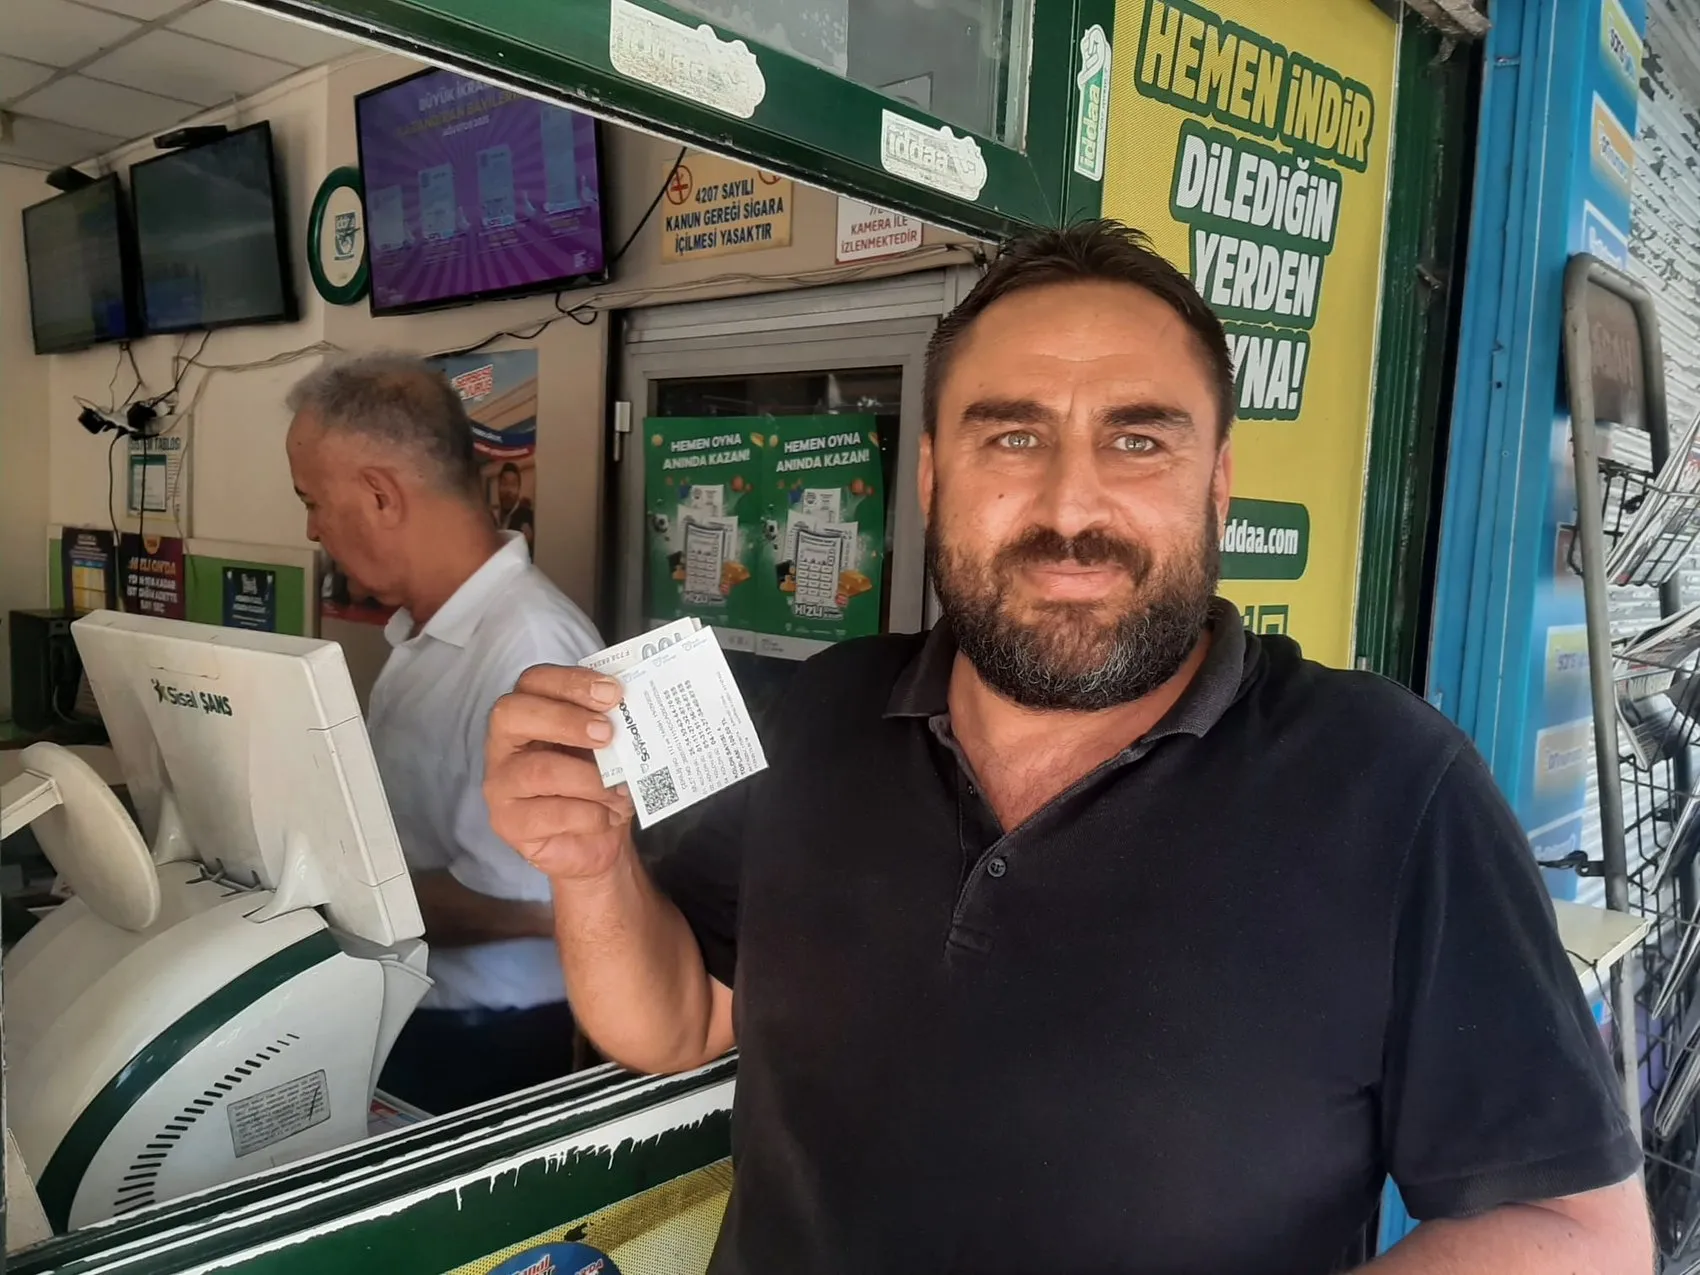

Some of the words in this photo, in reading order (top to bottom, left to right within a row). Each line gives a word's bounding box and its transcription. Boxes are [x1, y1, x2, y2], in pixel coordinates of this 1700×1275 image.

[1140, 0, 1284, 128] HEMEN
[1284, 61, 1371, 164] İNDİR
[1079, 84, 1100, 168] iddaa
[888, 124, 947, 170] iddaa
[695, 184, 719, 204] 4207
[721, 178, 754, 199] SAYILI
[1175, 134, 1338, 243] DİLEDİĞİN
[666, 211, 700, 231] KANUN
[703, 201, 740, 225] GEREĞİ
[743, 196, 783, 218] SİGARA
[851, 218, 891, 236] KAMERA
[675, 228, 717, 256] İÇİLMESİ
[720, 222, 772, 246] YASAKTIR
[840, 228, 917, 253] İZLENMEKTEDİR
[1194, 229, 1320, 318] YERDEN
[1226, 334, 1306, 411] YNA!
[670, 438, 711, 453] HEMEN
[712, 433, 742, 448] OYNA
[784, 437, 827, 454] HEMEN
[827, 432, 861, 448] OYNA
[663, 455, 708, 470] ANINDA
[708, 449, 751, 465] KAZAN!
[776, 457, 822, 472] ANINDA
[823, 449, 870, 467] KAZAN!
[794, 604, 823, 617] HIZLI
[167, 686, 198, 709] Sisal
[199, 692, 233, 716] ŞANS
